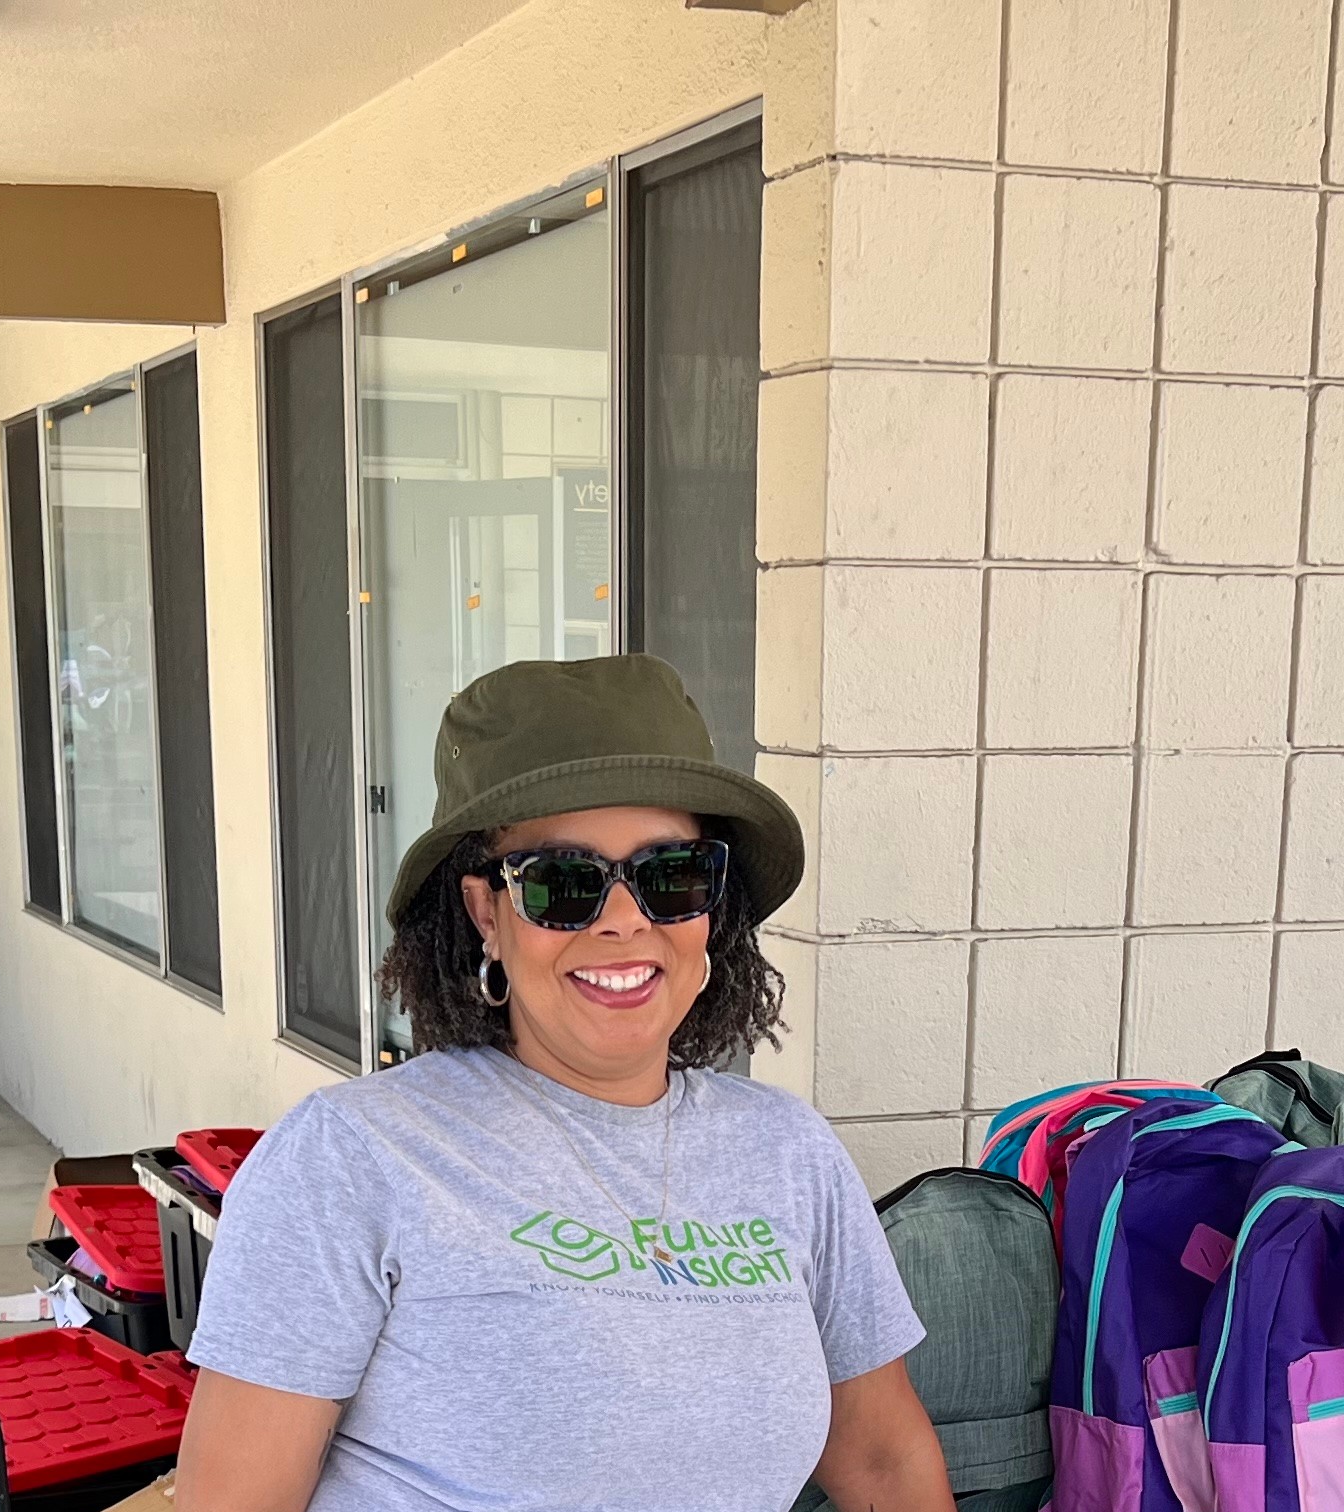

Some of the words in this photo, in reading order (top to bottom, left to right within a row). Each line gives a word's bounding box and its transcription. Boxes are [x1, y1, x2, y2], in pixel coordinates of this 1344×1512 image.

[631, 1217, 775, 1255] Future
[649, 1248, 792, 1289] INSIGHT
[593, 1286, 670, 1304] YOURSELF
[685, 1294, 719, 1304] FIND
[725, 1294, 762, 1304] YOUR
